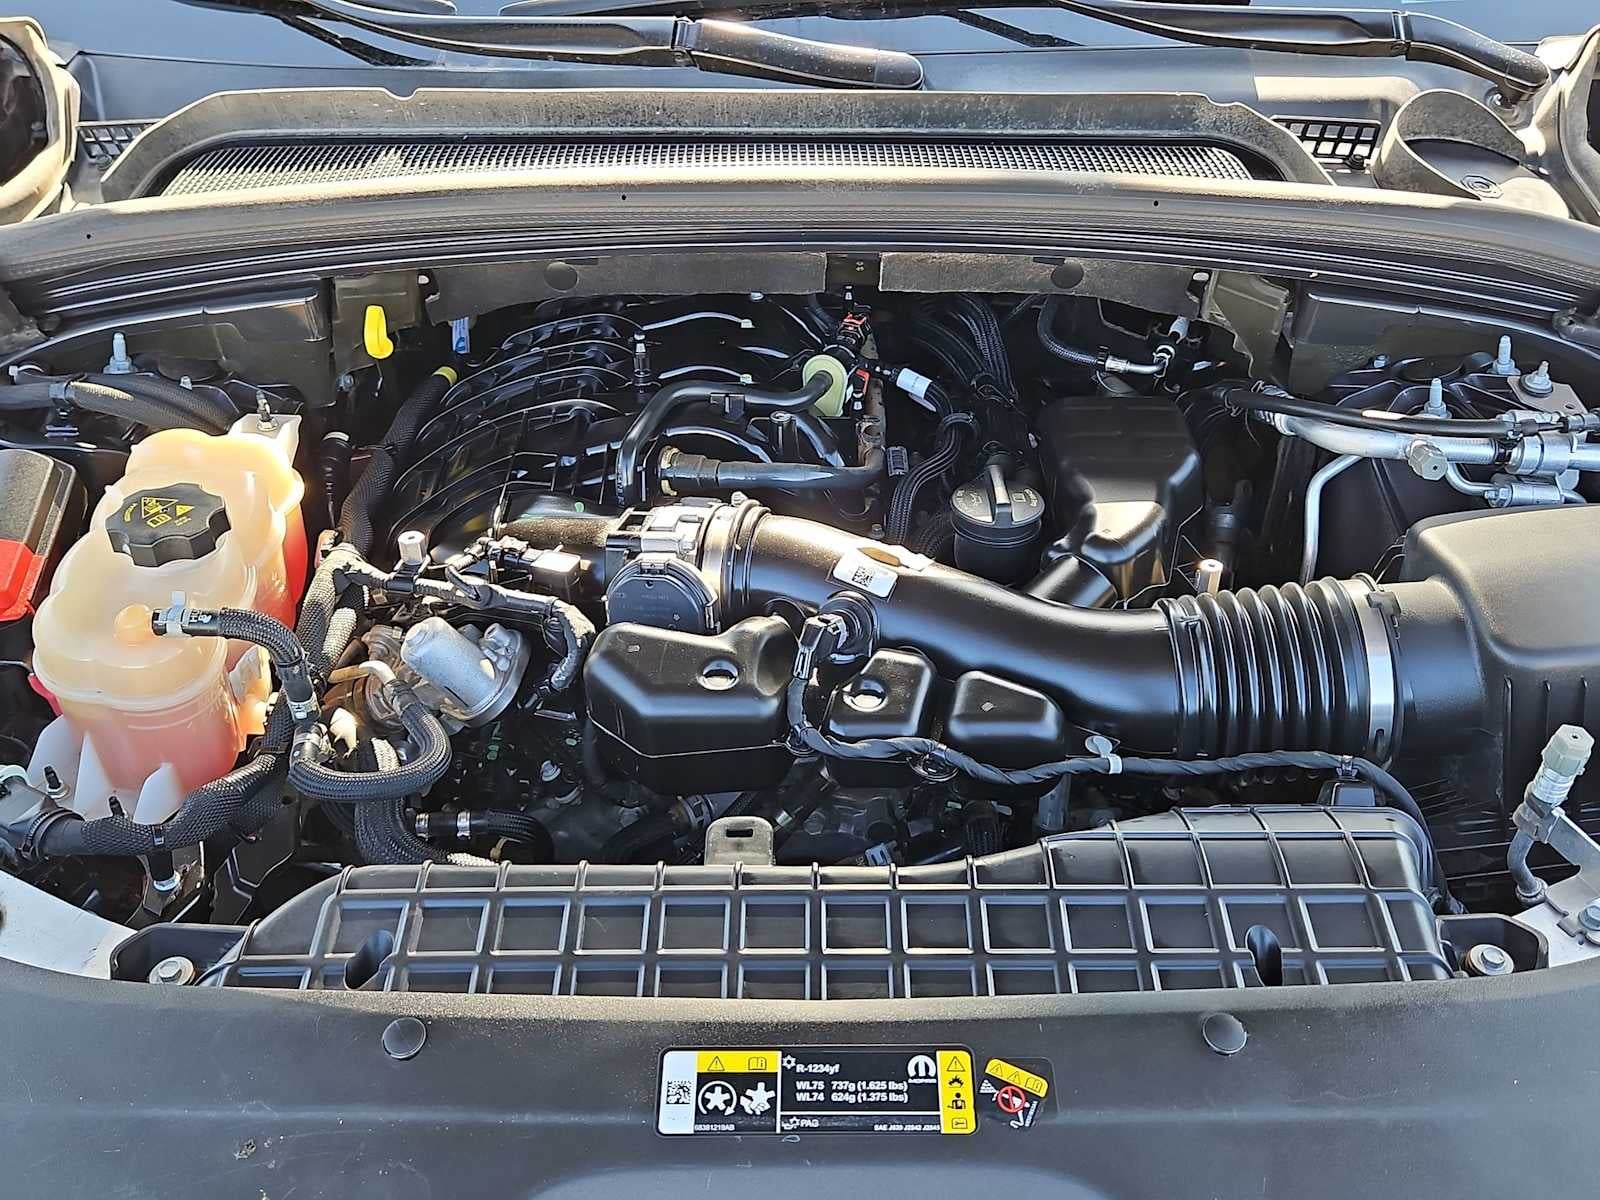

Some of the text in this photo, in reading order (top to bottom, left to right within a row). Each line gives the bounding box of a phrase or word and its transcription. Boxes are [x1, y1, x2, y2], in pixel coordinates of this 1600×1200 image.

[796, 1063, 840, 1075] R-1234yf
[796, 1081, 908, 1092] WL75 737g (1.625 lbs)
[796, 1092, 908, 1103] WL74 624g (1.375 lbs)
[800, 1119, 819, 1128] PAG
